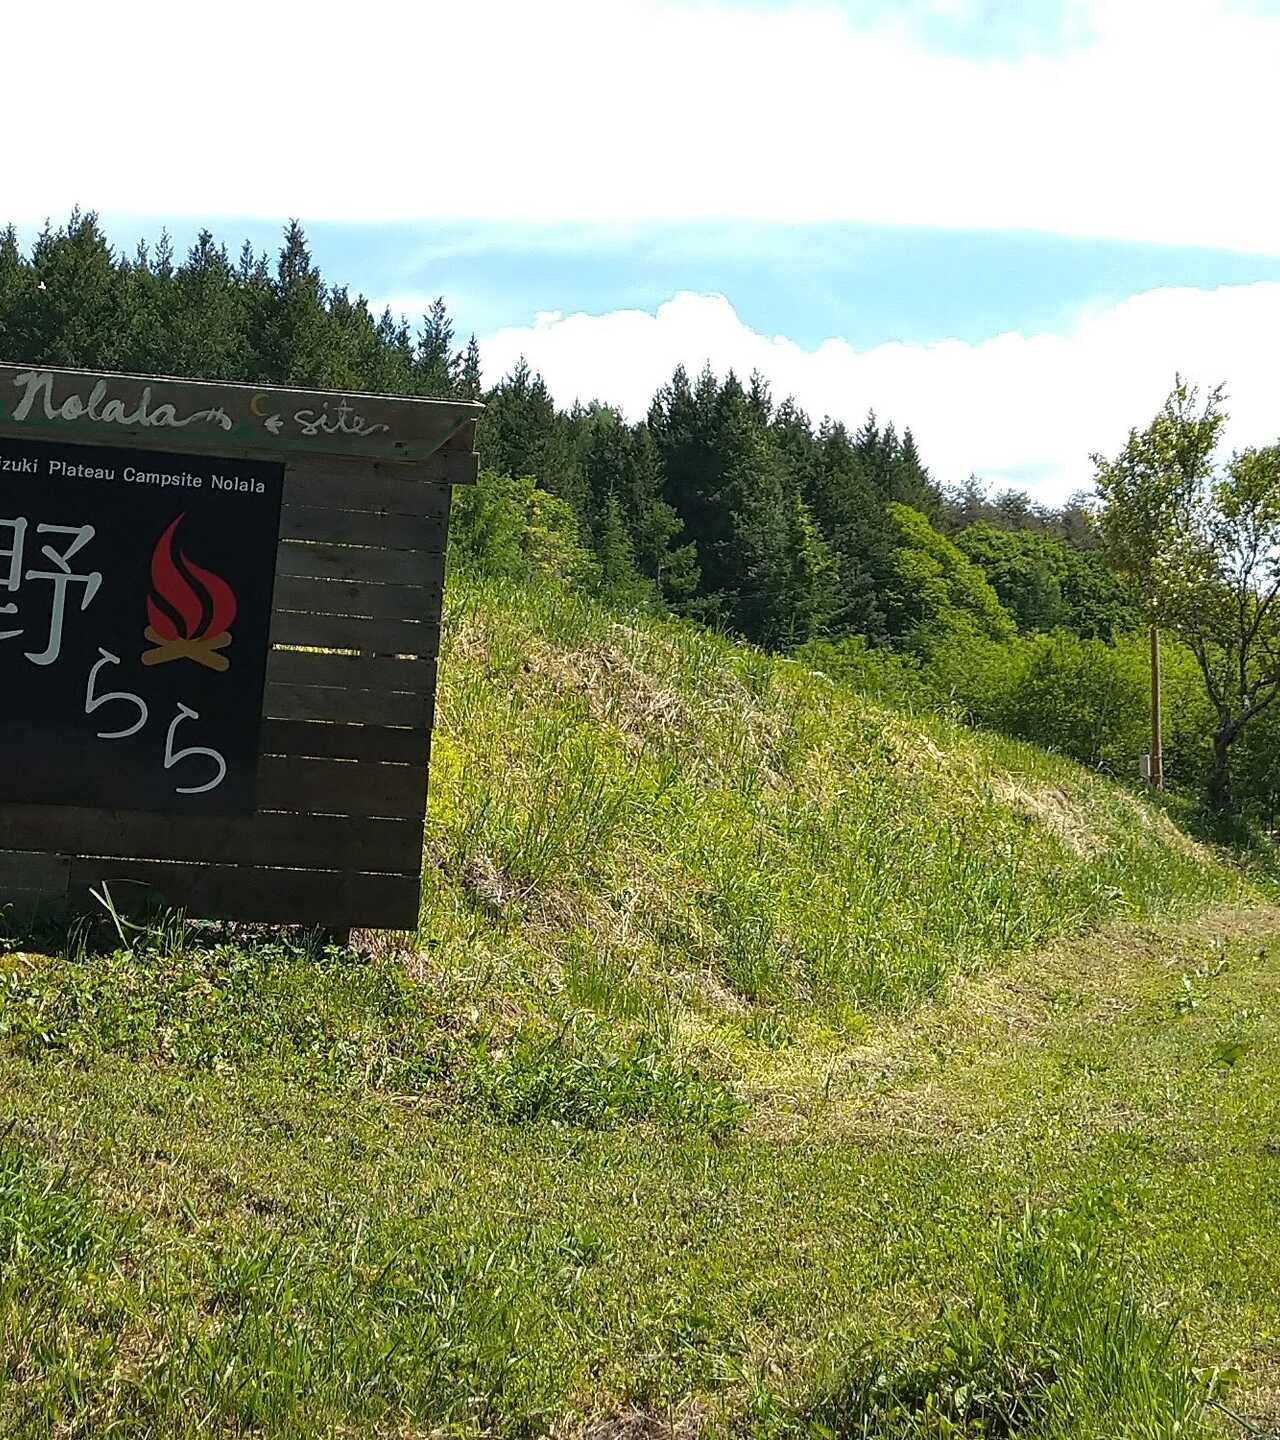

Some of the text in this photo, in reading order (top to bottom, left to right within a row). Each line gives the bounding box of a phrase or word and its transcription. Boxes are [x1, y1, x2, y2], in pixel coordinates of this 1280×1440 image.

[12, 371, 232, 431] Nolala
[294, 398, 390, 436] site
[48, 460, 115, 480] Plateau
[123, 467, 202, 489] Campsite
[211, 475, 266, 494] Nolala
